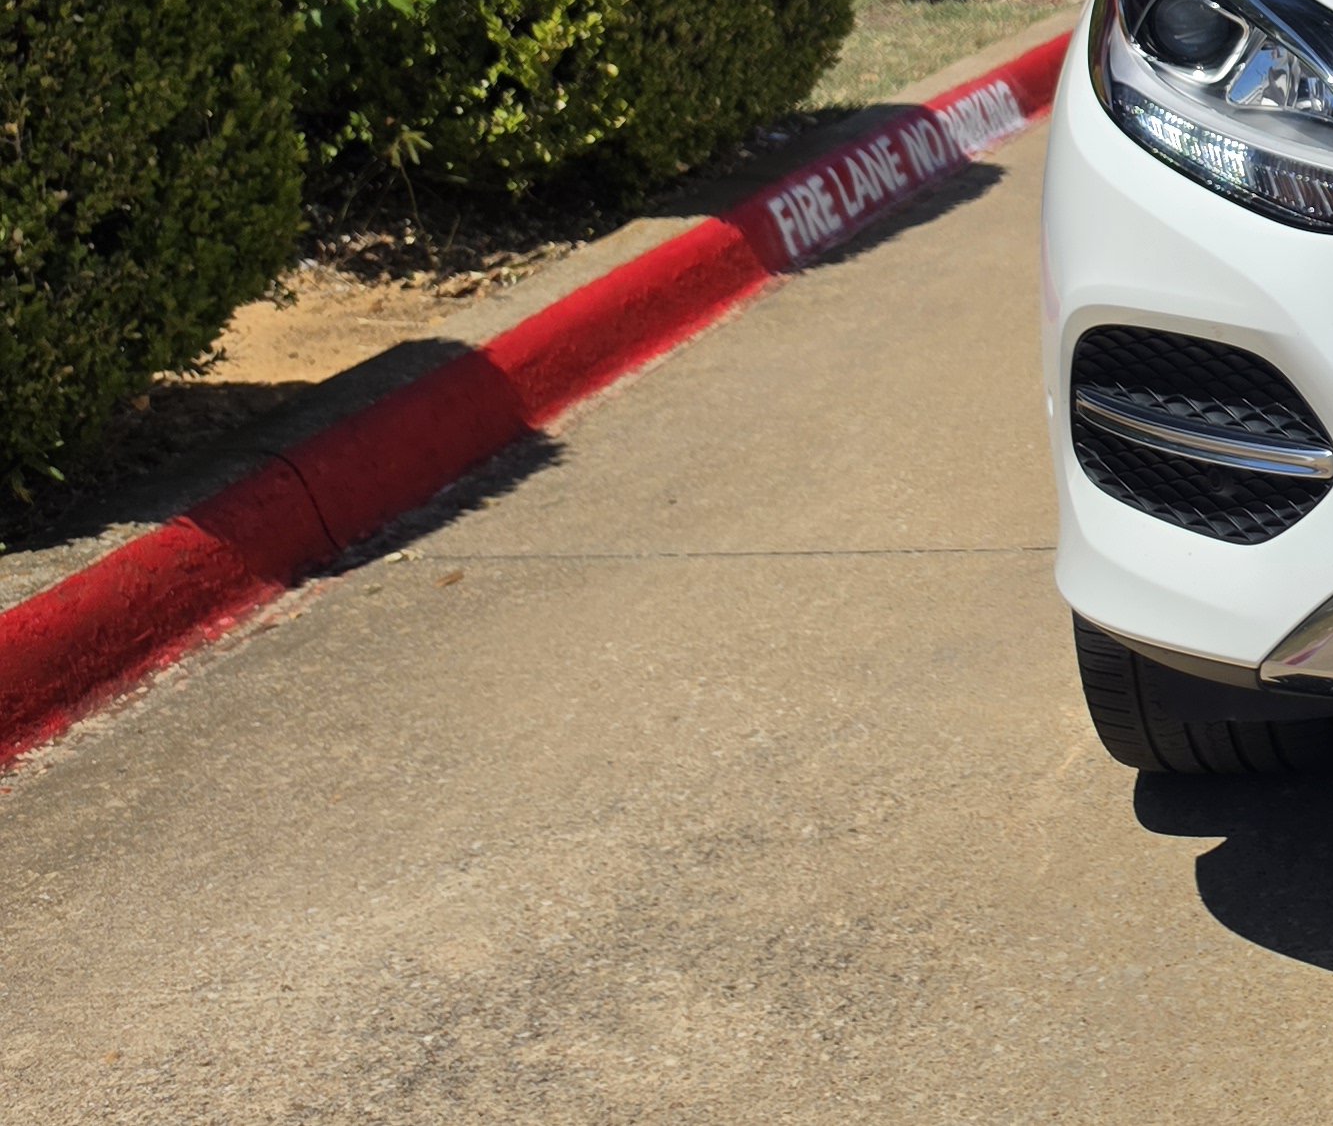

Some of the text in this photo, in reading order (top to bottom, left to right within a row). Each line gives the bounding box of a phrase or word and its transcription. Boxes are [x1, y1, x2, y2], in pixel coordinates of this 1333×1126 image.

[768, 79, 1026, 258] FIRE LANE NO PARKING
